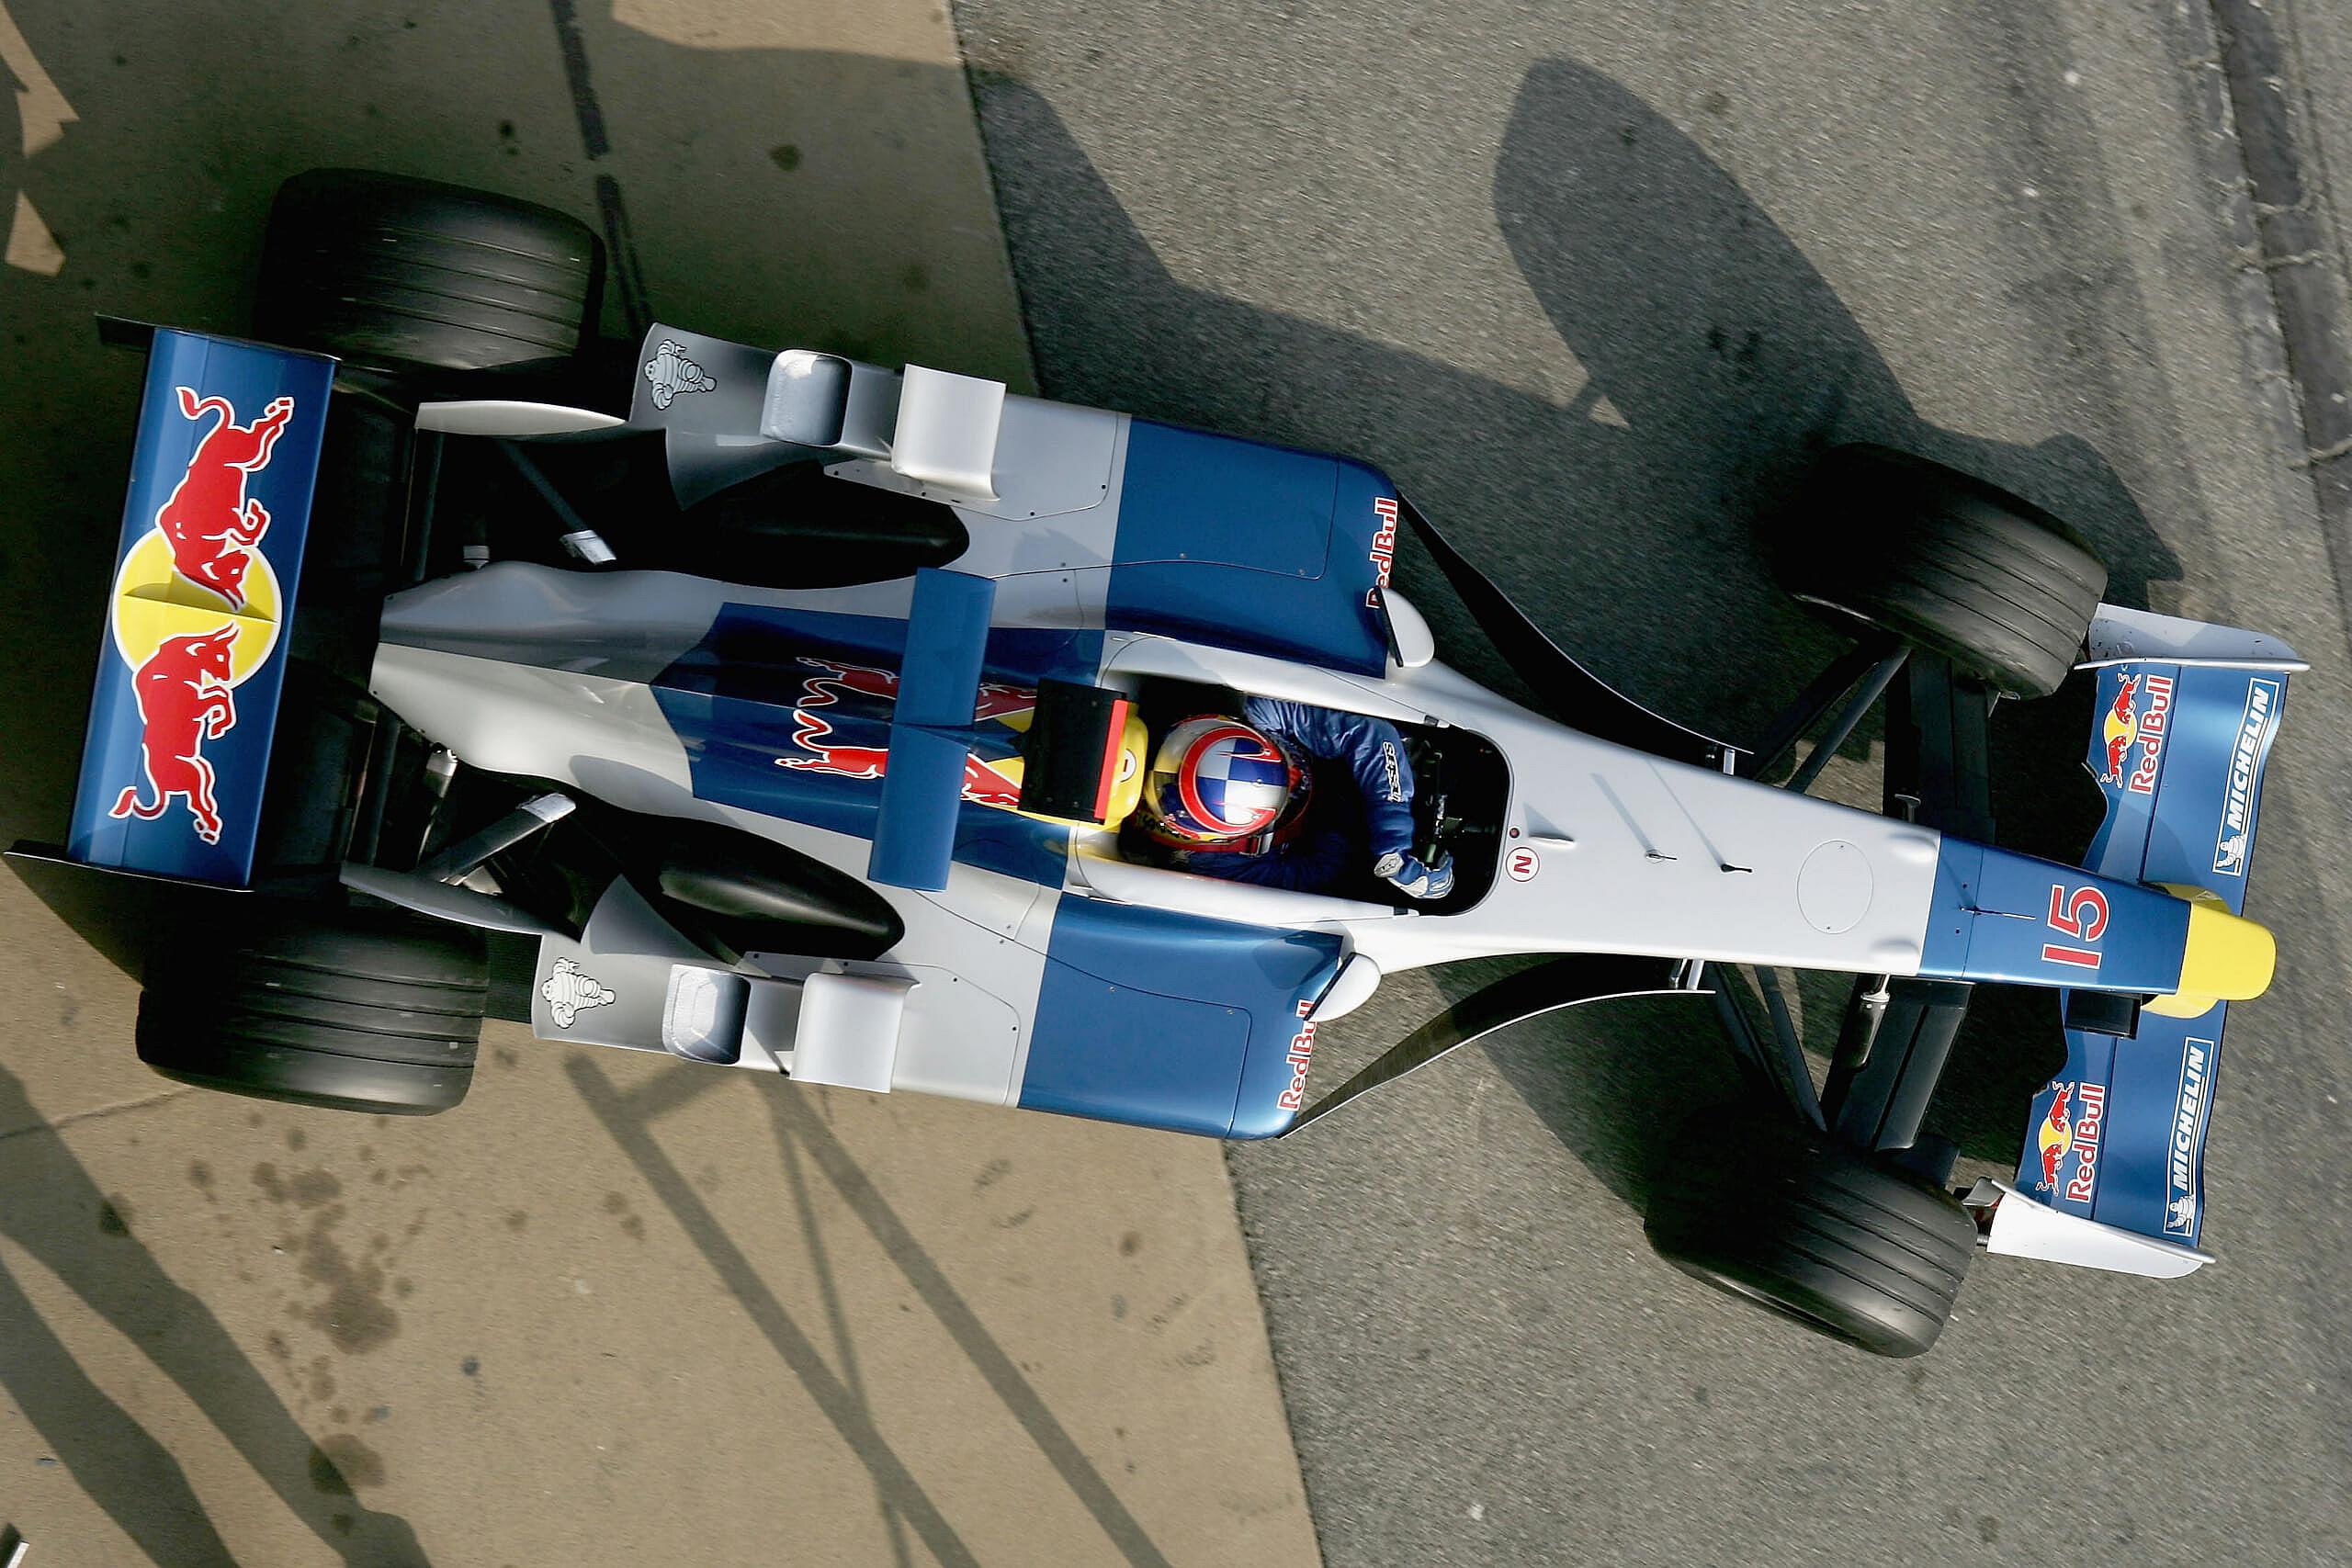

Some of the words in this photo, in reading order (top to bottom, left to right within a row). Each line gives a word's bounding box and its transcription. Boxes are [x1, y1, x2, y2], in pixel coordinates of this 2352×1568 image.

[2227, 686, 2270, 831] MICHELIN
[1513, 855, 1532, 874] N
[2041, 884, 2110, 970] 15
[2172, 1045, 2205, 1192] MICHELIN
